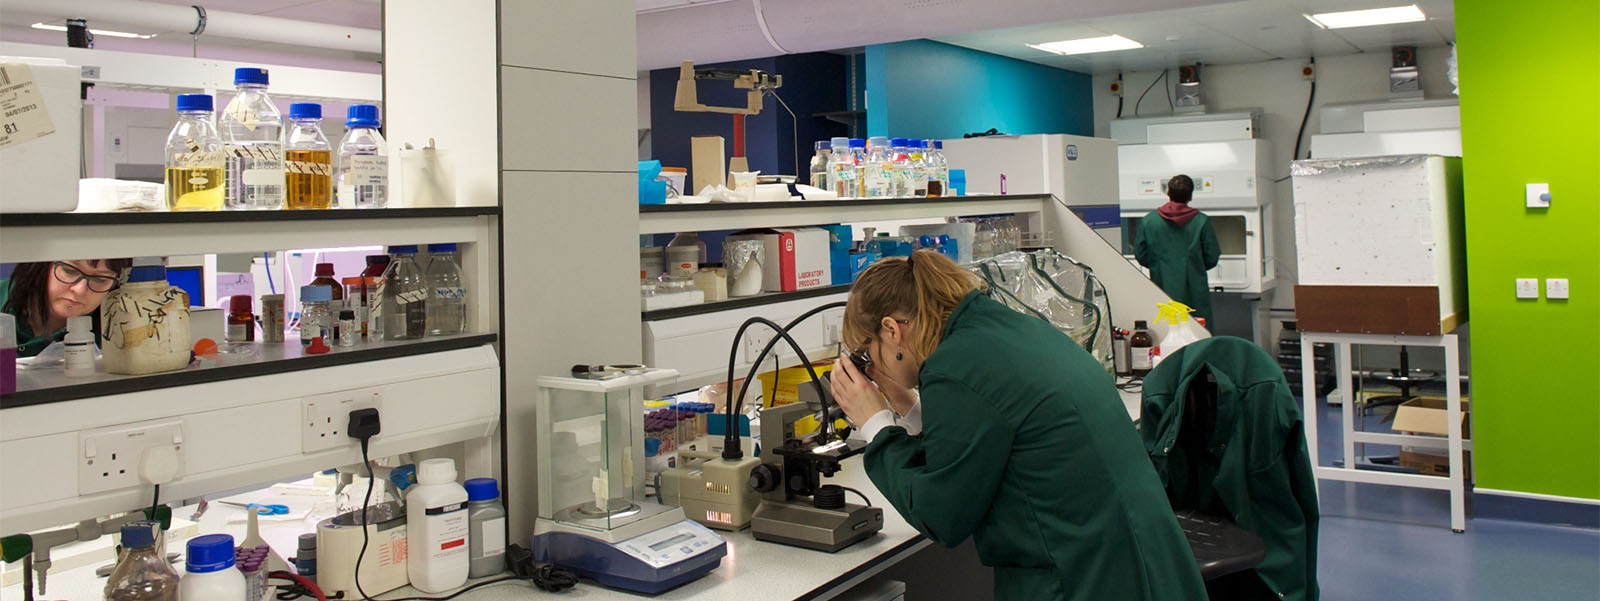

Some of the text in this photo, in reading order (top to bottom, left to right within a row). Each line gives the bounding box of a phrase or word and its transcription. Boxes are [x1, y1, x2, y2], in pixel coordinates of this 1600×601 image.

[4, 122, 18, 134] 81
[798, 270, 824, 279] LABORATORY
[799, 278, 820, 287] PRODUCTS
